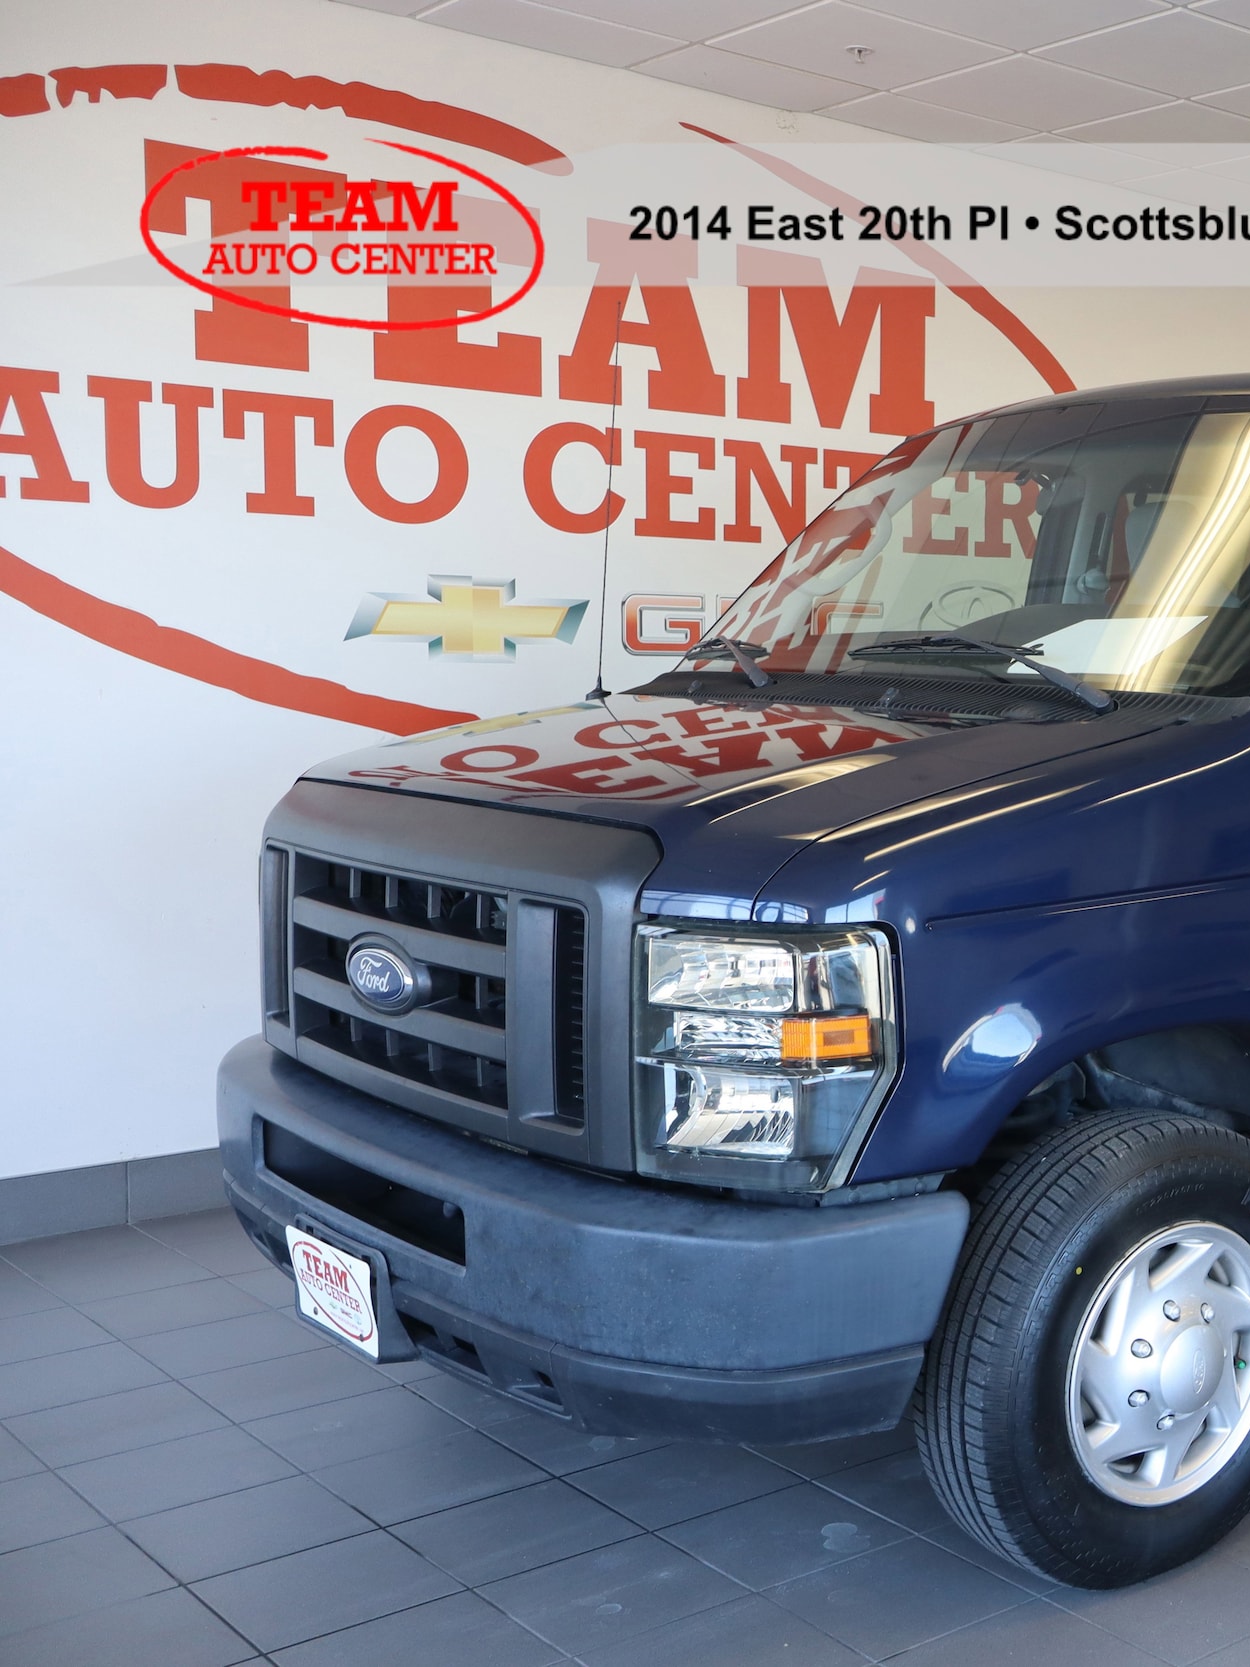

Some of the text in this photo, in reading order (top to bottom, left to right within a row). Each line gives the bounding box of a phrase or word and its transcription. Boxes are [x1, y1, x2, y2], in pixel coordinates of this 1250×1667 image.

[357, 956, 390, 992] Ford
[300, 1268, 363, 1314] AUTO CENTER
[302, 1249, 350, 1294] TEAM
